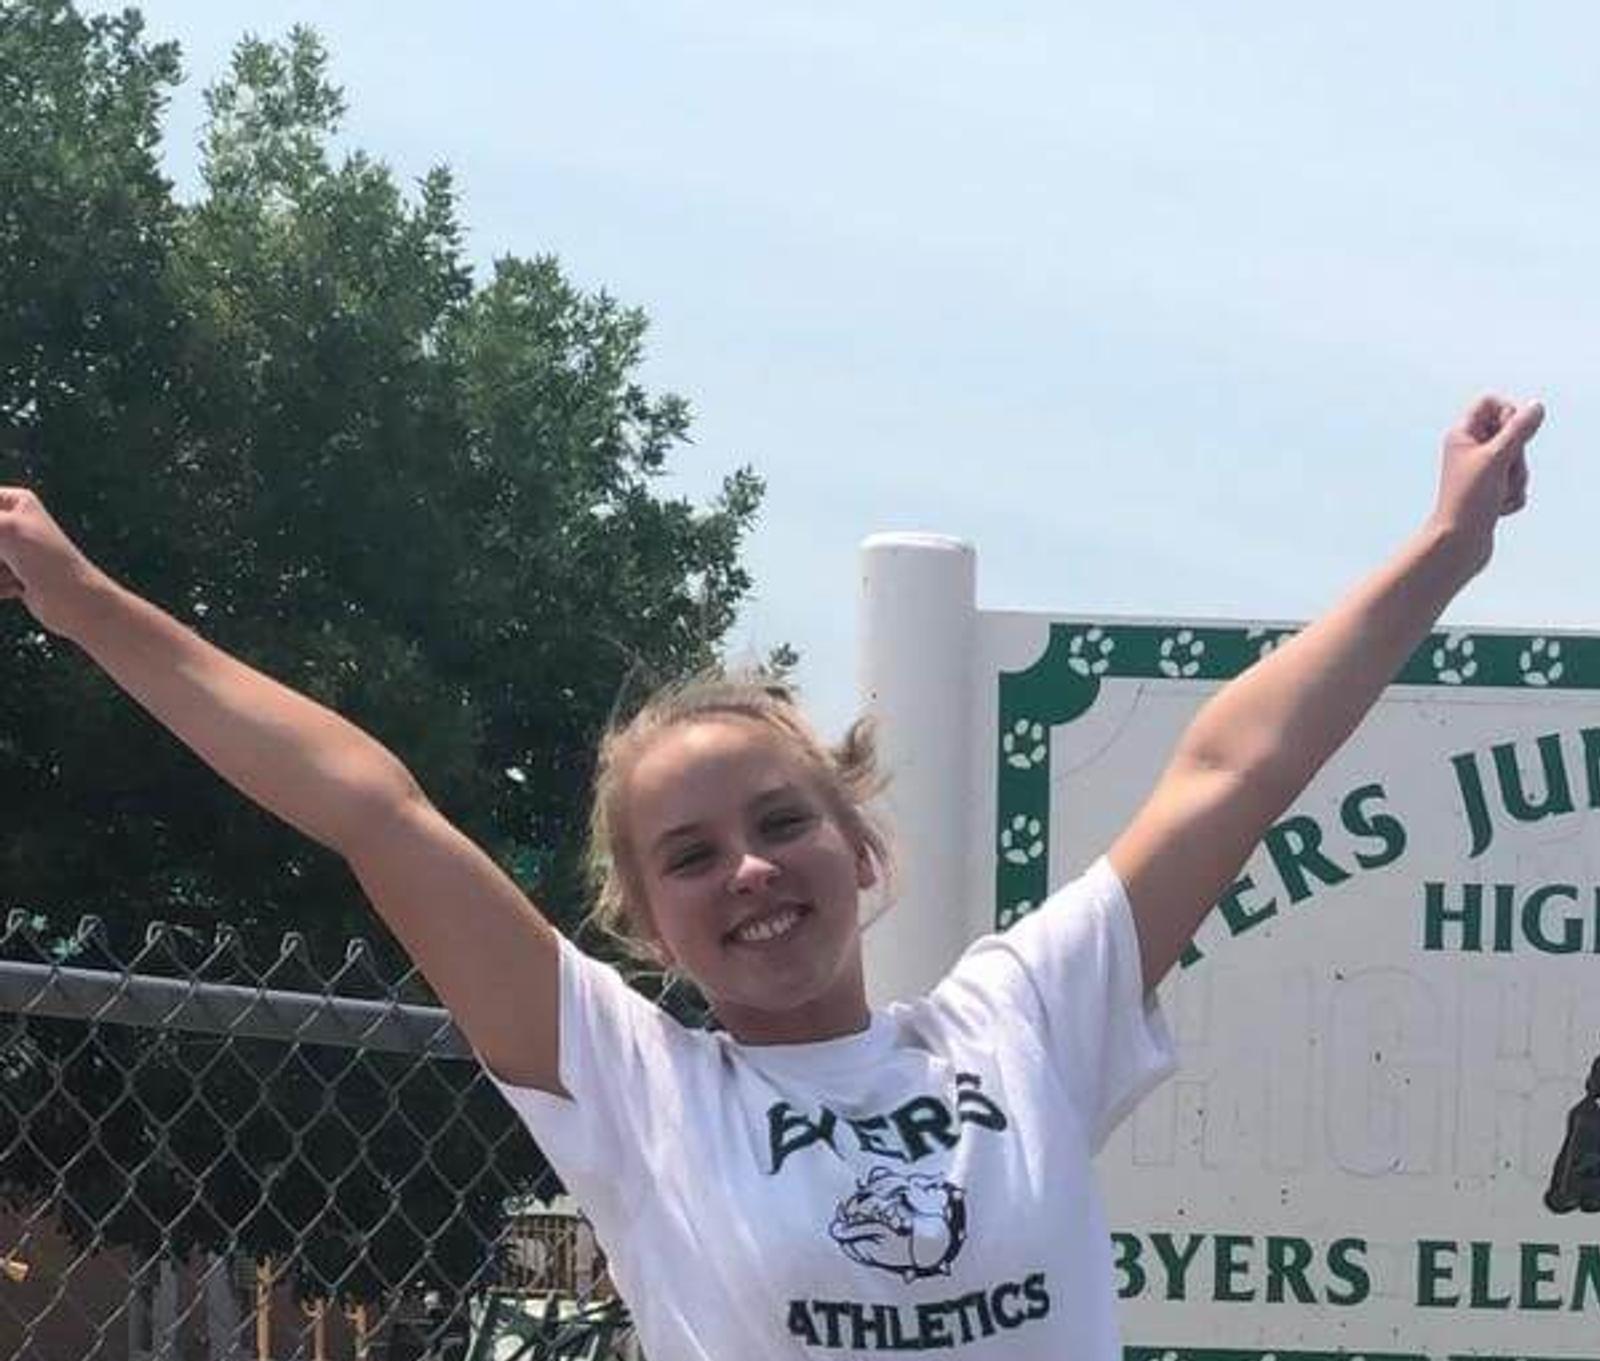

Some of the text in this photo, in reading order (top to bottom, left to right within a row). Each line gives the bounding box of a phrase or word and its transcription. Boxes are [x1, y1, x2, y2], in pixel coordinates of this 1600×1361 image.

[1178, 782, 1408, 970] ERS
[1109, 1231, 1371, 1306] BYERS
[787, 1272, 1051, 1351] ATHLETICS
